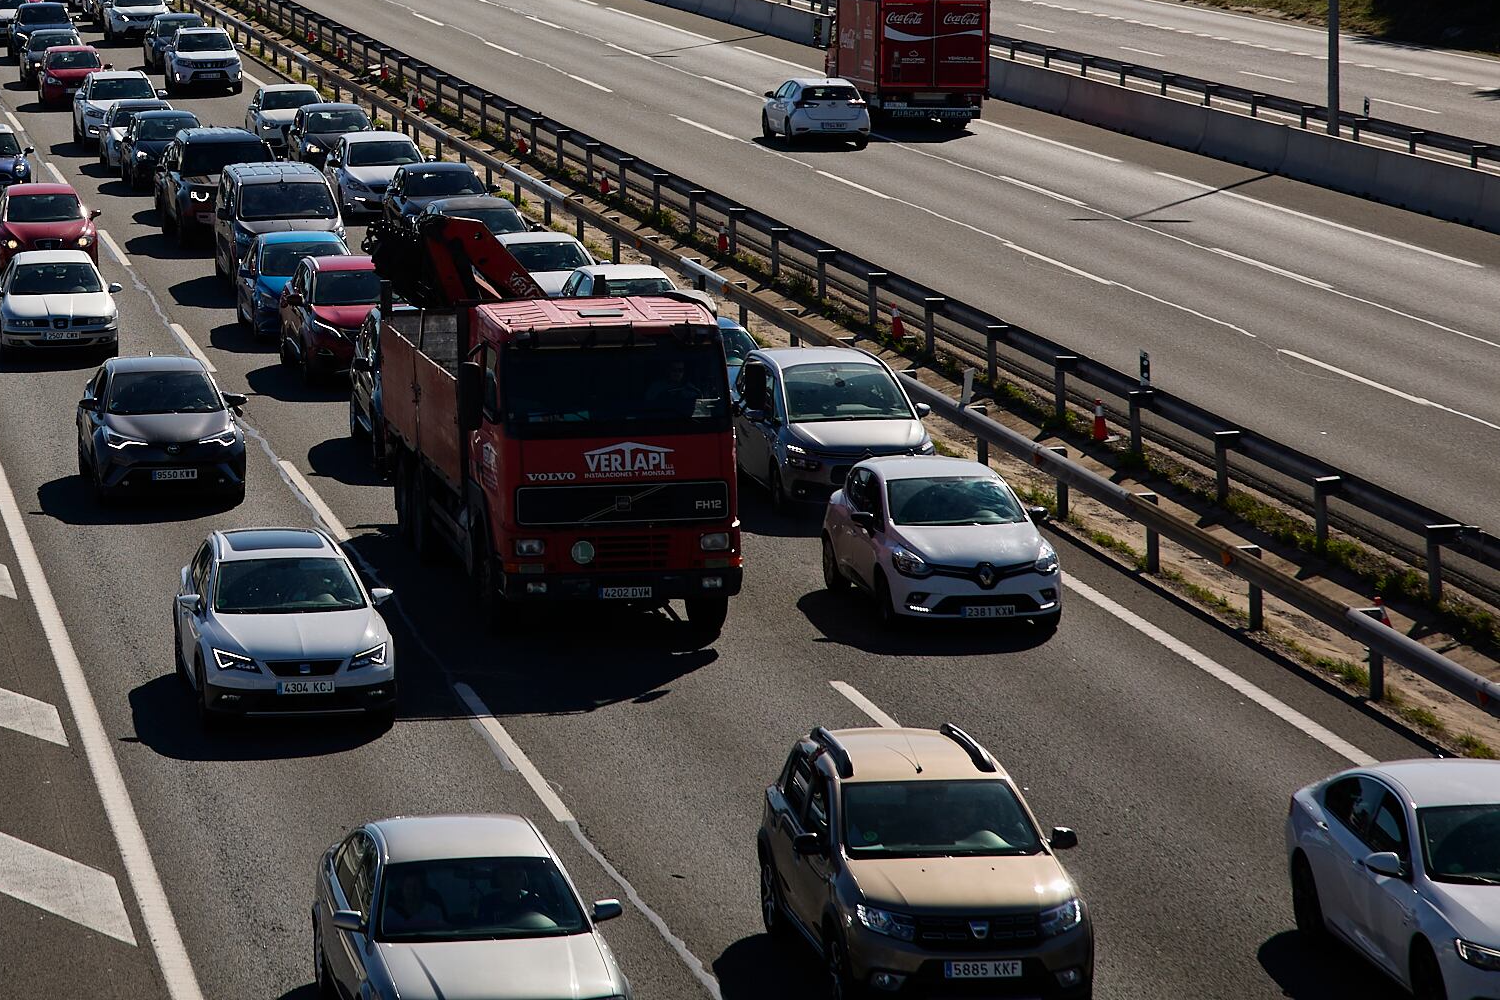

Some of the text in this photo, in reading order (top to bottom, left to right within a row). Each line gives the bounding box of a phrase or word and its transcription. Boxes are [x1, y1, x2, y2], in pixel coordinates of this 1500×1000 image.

[157, 471, 177, 479] 9550
[526, 472, 576, 481] VOLVO
[585, 471, 632, 479] INSTALACIONES
[695, 500, 722, 509] FH12
[604, 588, 629, 597] 4202
[968, 608, 991, 616] 2381
[285, 682, 333, 692] 4304 KCJ
[954, 962, 1018, 976] 5885 KKF
